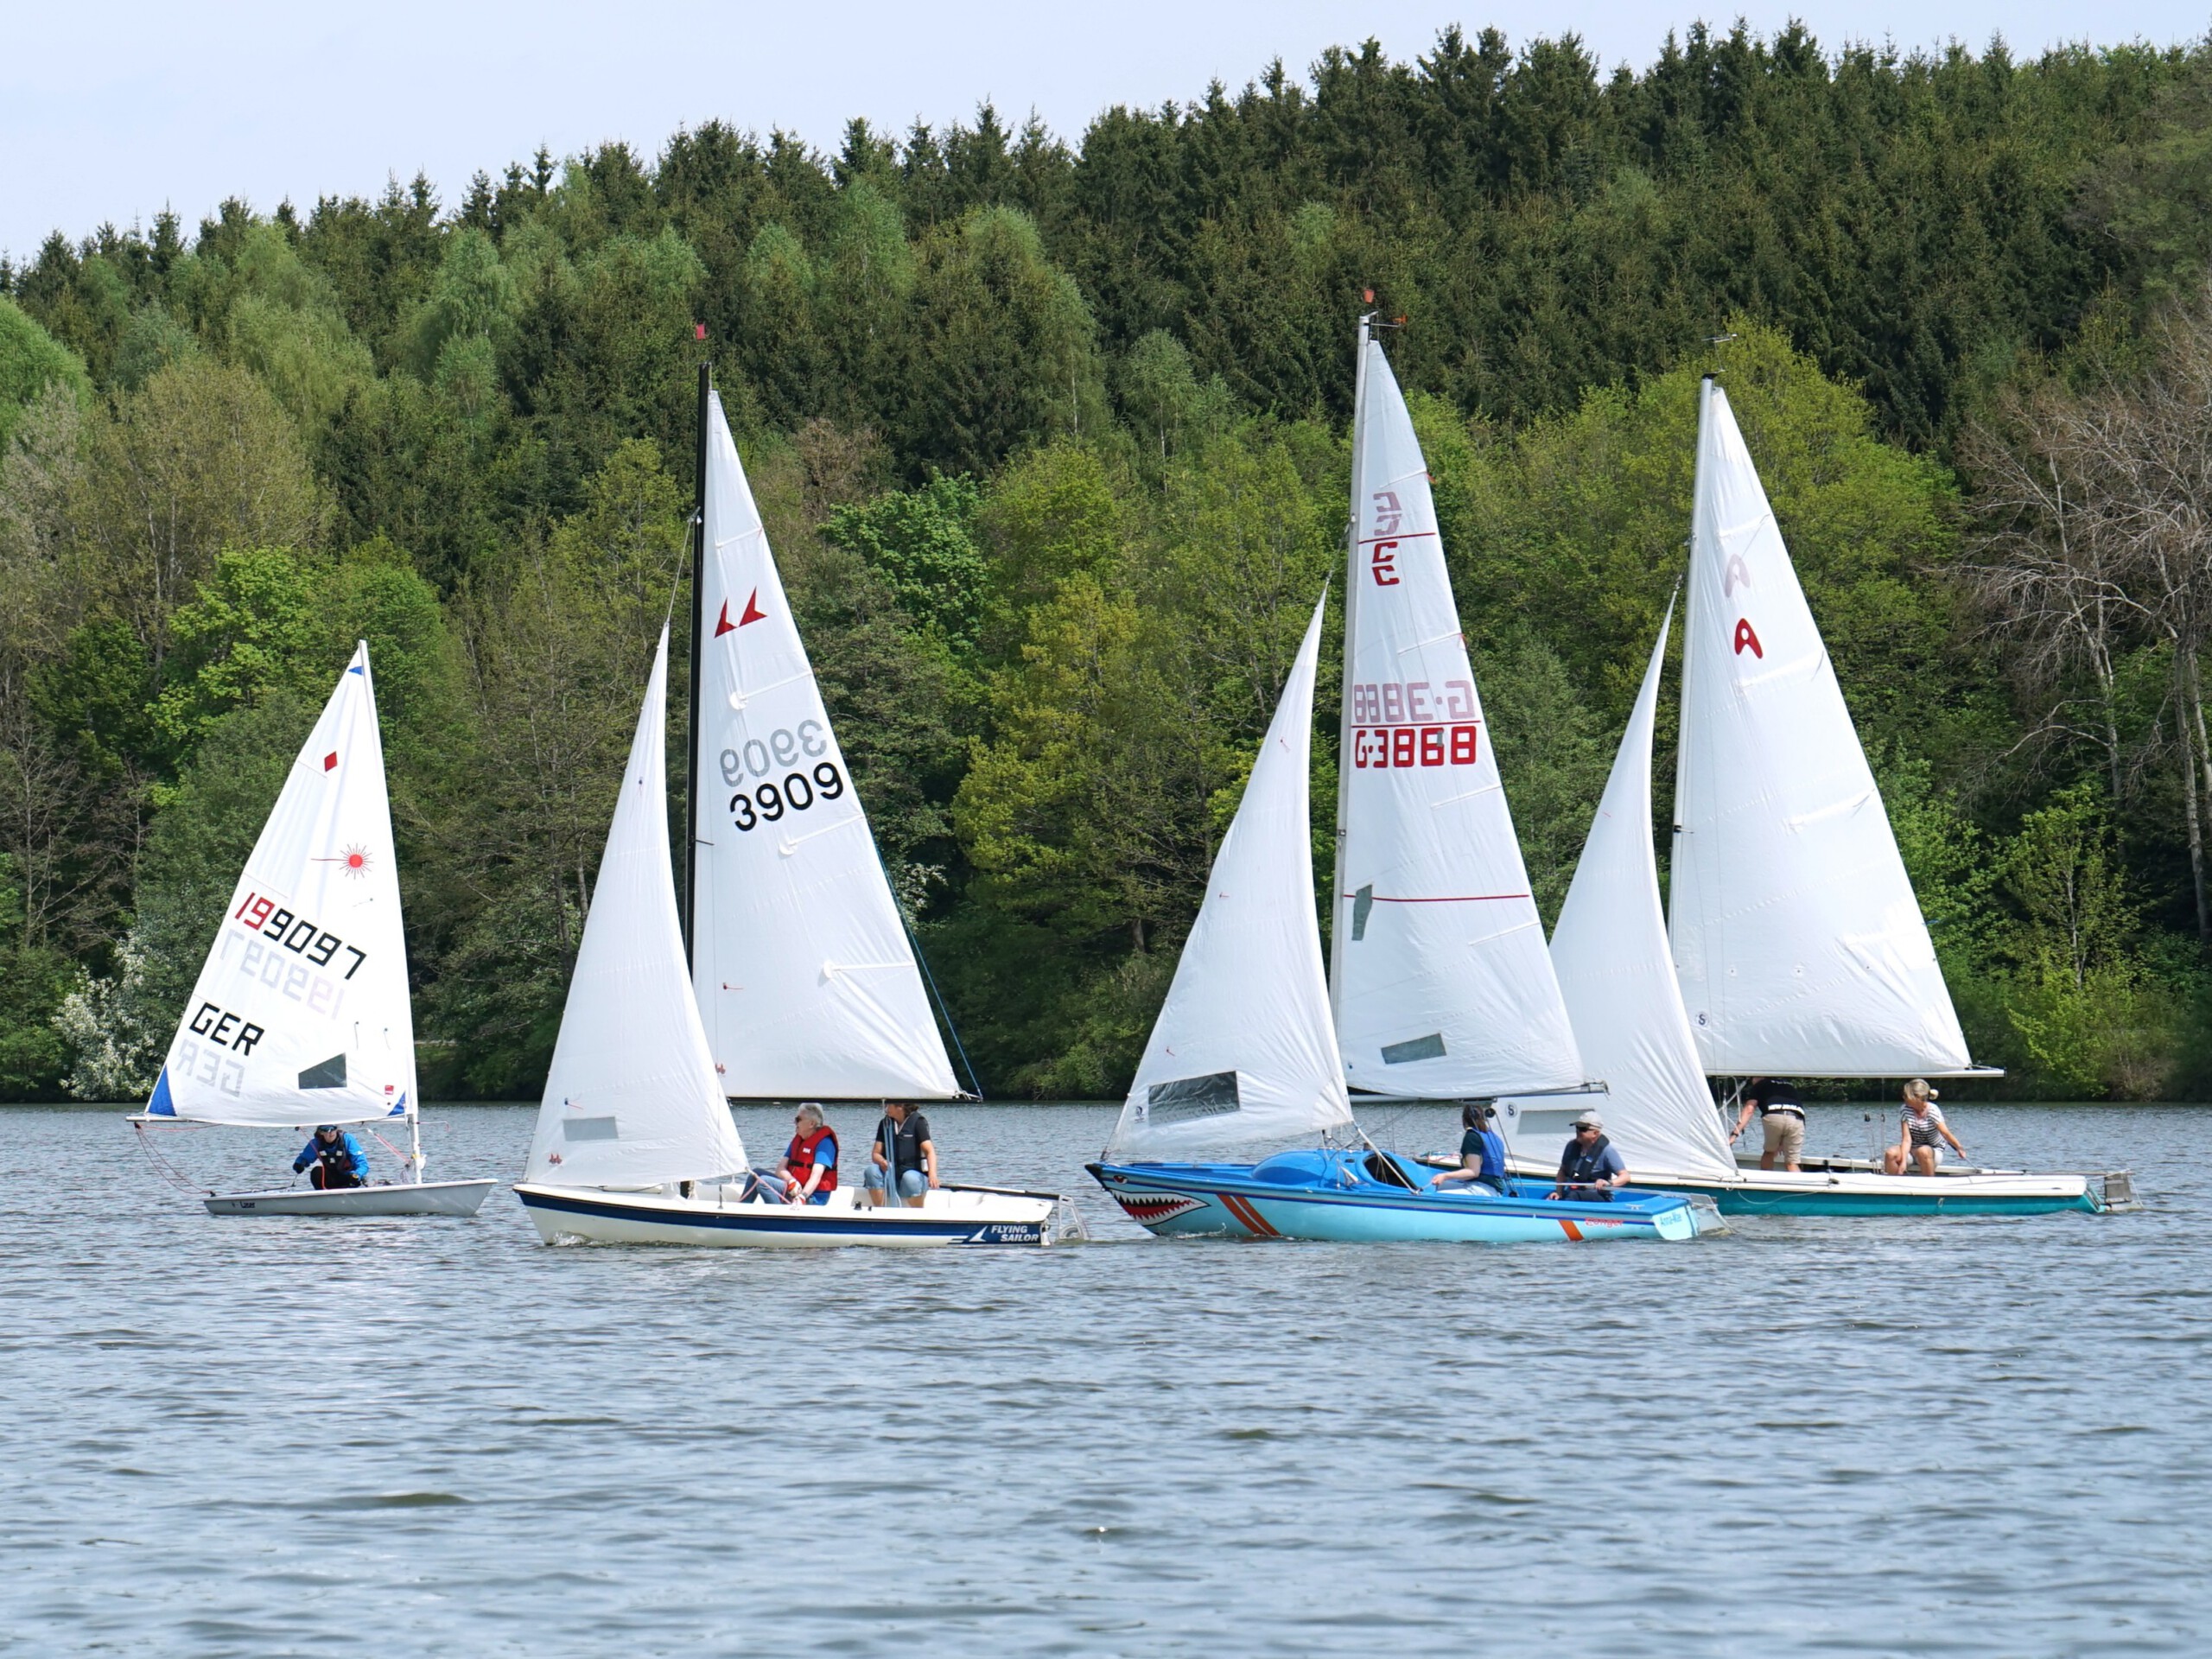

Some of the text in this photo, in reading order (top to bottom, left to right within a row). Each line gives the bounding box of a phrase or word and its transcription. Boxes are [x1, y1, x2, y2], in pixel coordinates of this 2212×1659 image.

[1734, 618, 1763, 659] A
[729, 762, 843, 831] 3909
[234, 892, 367, 980] 199097
[189, 1002, 264, 1057] GER
[991, 1224, 1028, 1234] FLYING
[1000, 1233, 1039, 1242] SAILOR
